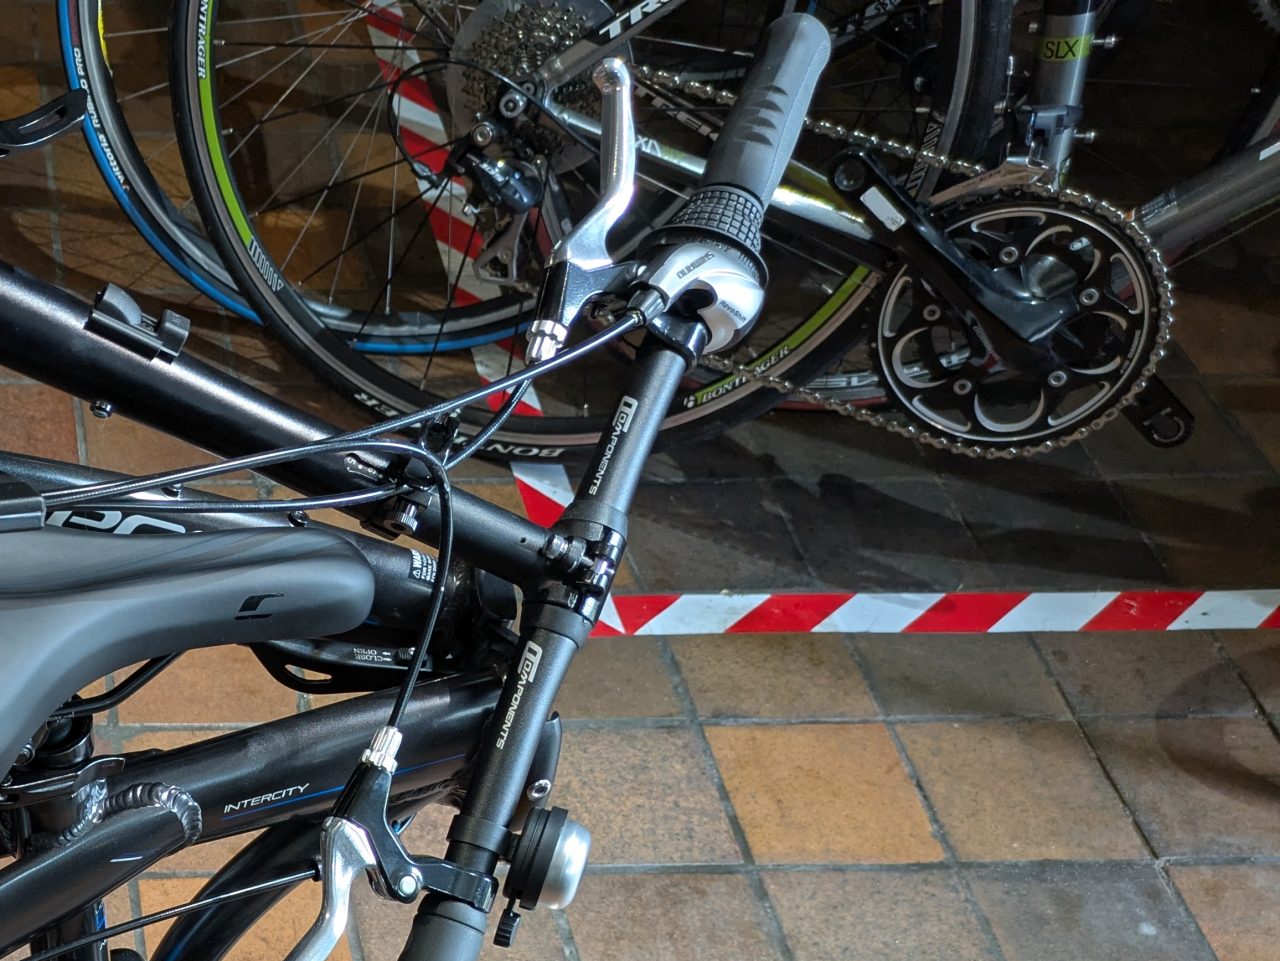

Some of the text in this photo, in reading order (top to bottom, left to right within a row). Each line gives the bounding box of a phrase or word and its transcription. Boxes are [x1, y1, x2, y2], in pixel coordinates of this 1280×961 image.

[197, 0, 208, 78] NTRAGER
[1043, 39, 1080, 60] SLX
[73, 47, 86, 76] PRO
[702, 345, 790, 403] BONTAGER
[223, 782, 310, 814] INTERCITY
